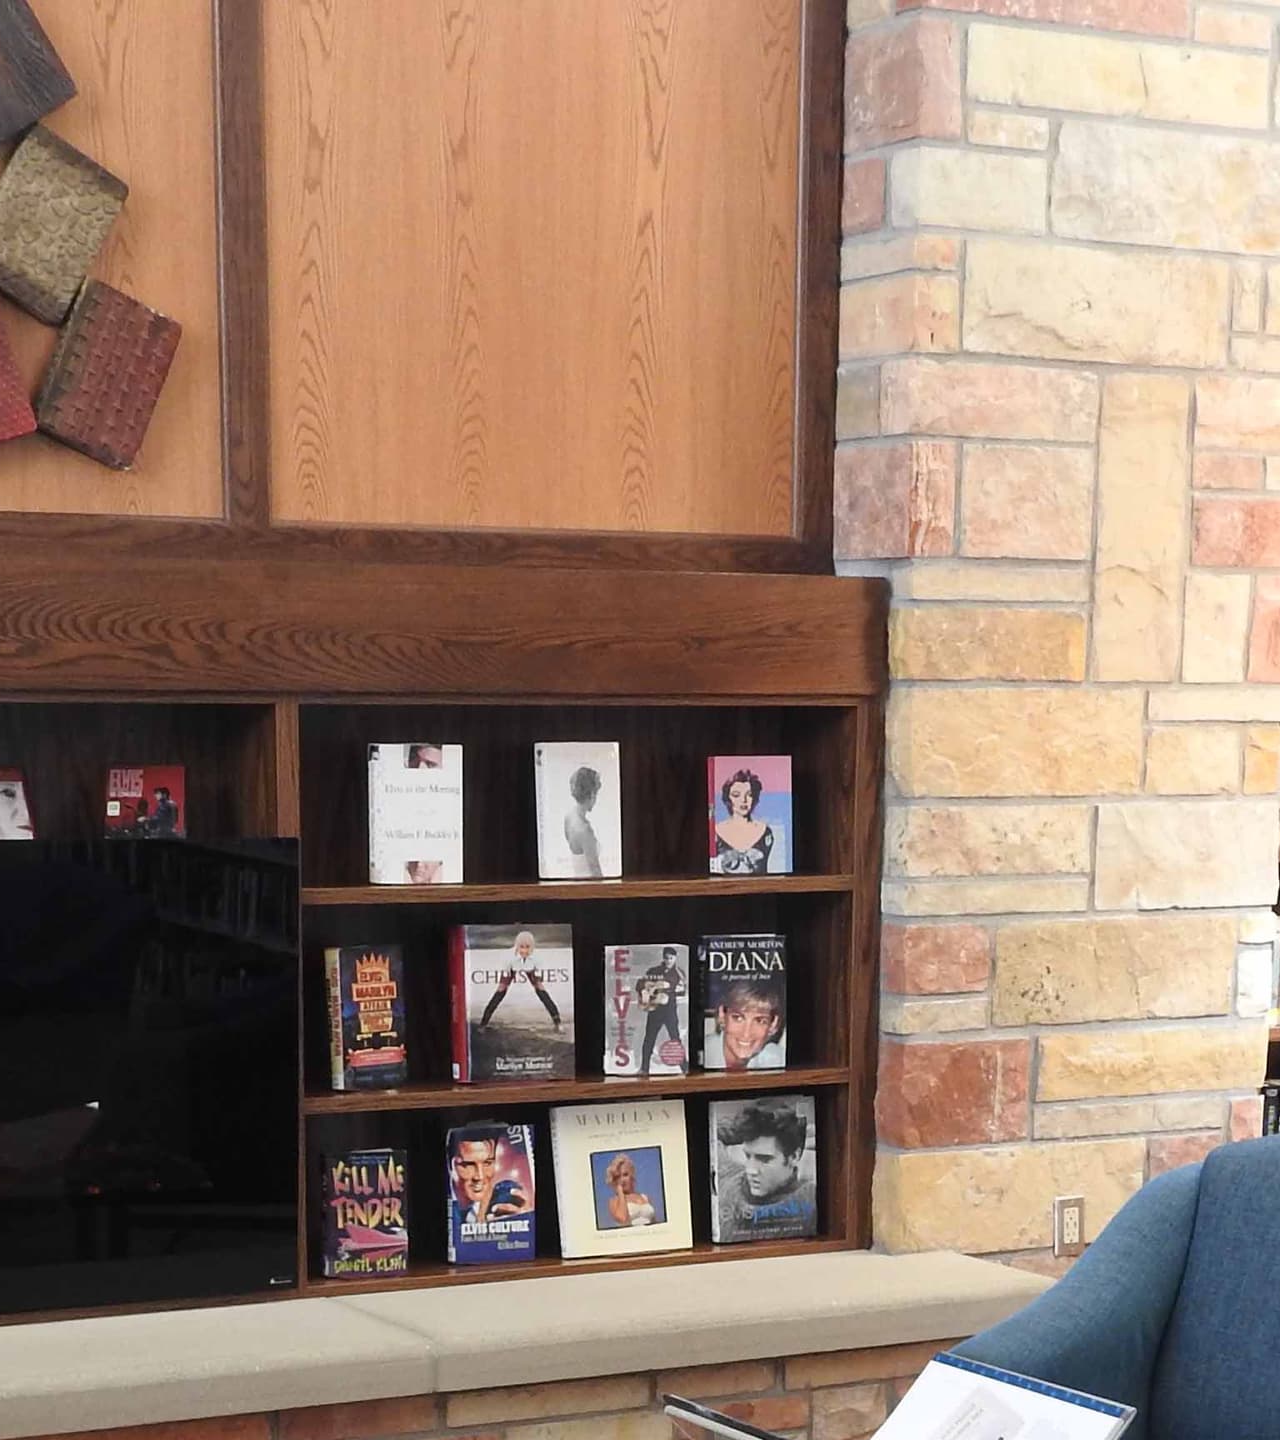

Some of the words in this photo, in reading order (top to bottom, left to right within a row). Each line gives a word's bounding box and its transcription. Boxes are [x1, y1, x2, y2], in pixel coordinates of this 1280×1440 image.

[709, 941, 744, 949] ANDREW
[747, 941, 784, 949] MORTON
[709, 951, 784, 972] DIANA
[613, 949, 630, 1067] ELVIS
[575, 1108, 671, 1126] MARILYN
[332, 1160, 374, 1195] KILL
[330, 1197, 403, 1229] TENDER
[461, 1223, 488, 1235] ELVIS
[488, 1220, 530, 1233] CULTURE
